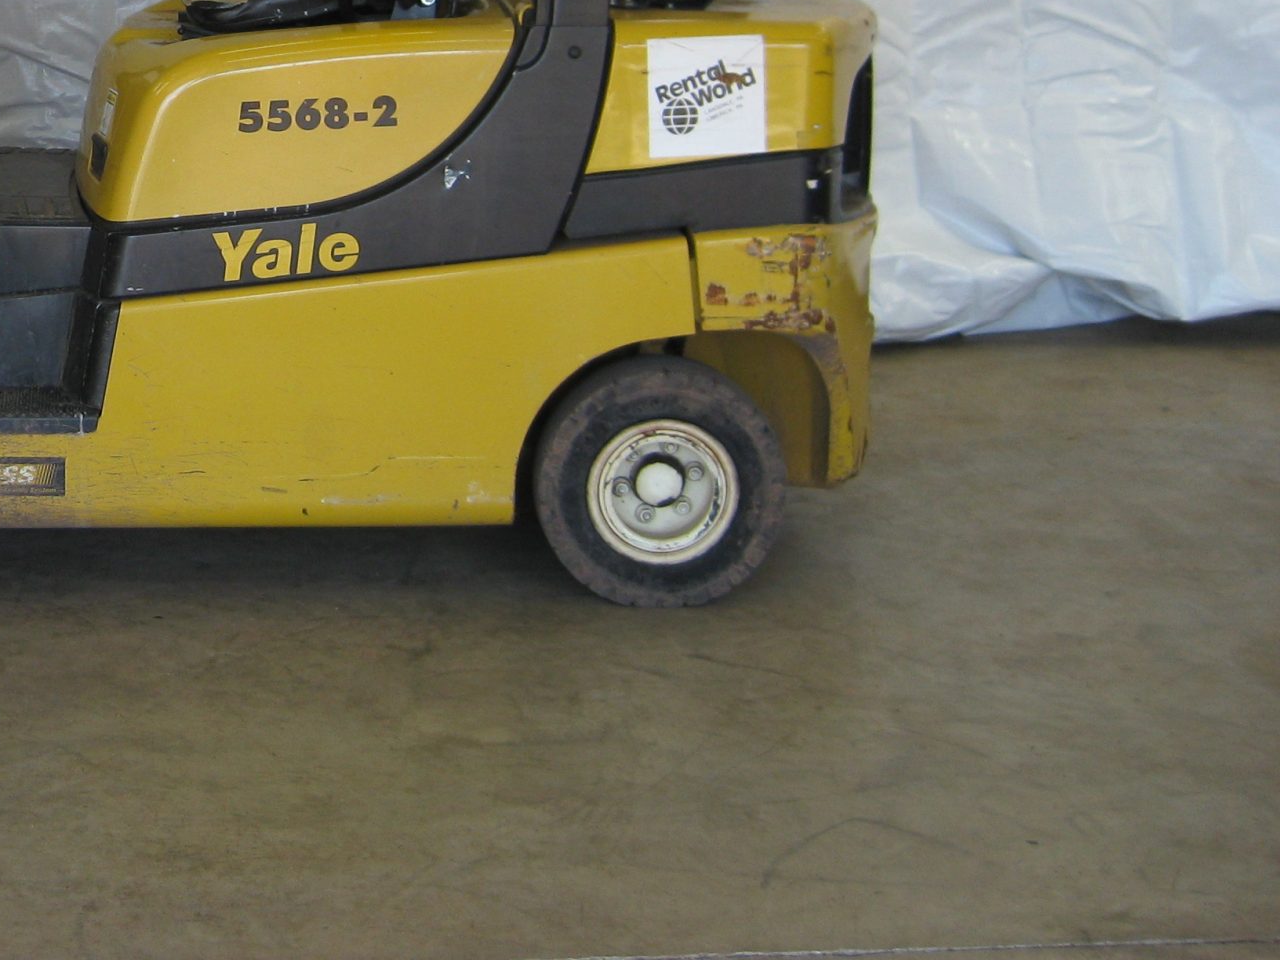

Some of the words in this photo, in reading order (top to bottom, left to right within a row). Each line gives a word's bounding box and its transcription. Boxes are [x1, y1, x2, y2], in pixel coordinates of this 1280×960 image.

[655, 59, 726, 103] Rental
[238, 95, 398, 133] 5568-2
[212, 223, 360, 282] Yale
